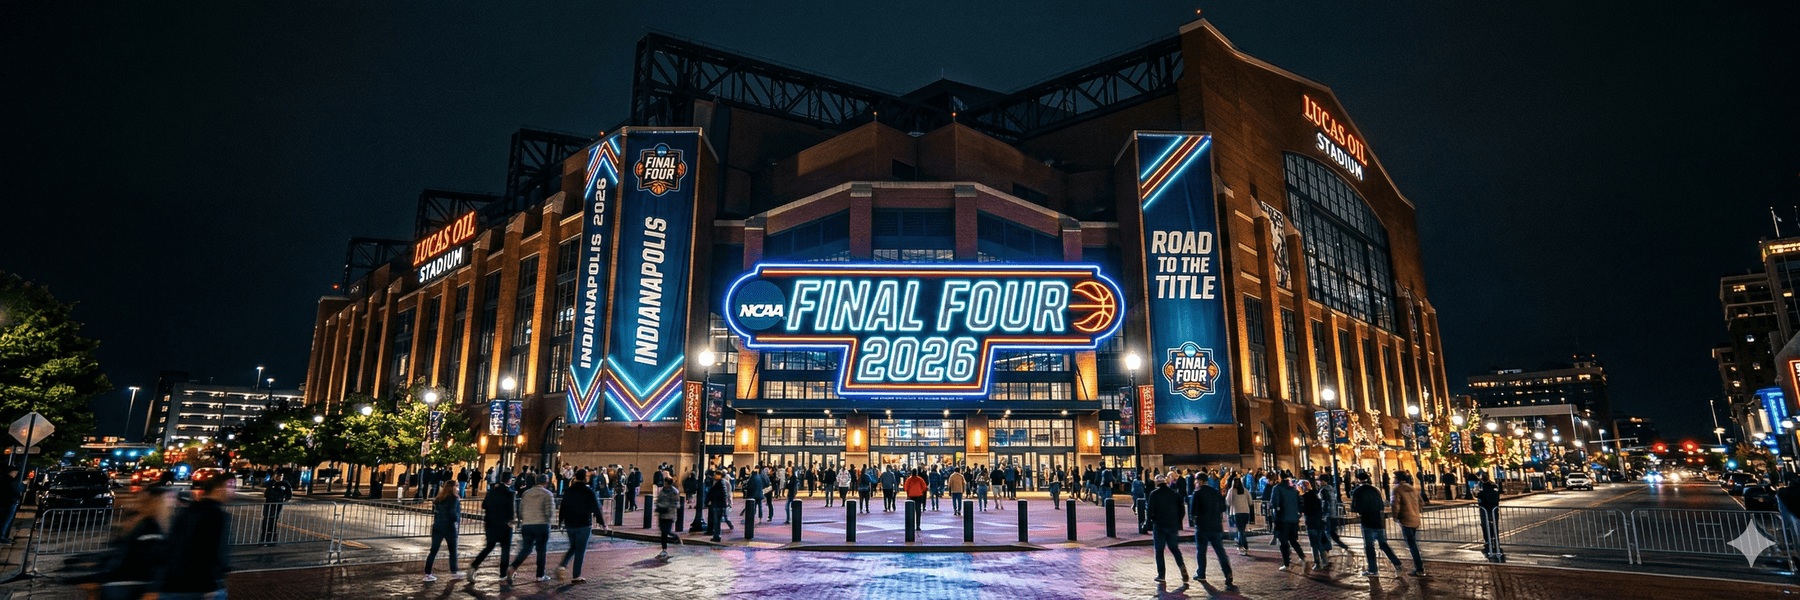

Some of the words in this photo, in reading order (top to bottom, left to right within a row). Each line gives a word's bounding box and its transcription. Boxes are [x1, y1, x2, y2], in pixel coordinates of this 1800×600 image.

[1304, 94, 1345, 146] LUCAS
[1347, 133, 1368, 166] OIL
[645, 156, 676, 169] FINAL
[1316, 132, 1363, 181] STADIUM
[644, 168, 675, 180] FOUR
[413, 225, 451, 266] LUCAS
[452, 211, 475, 244] OIL
[1151, 230, 1213, 255] ROAD
[419, 246, 463, 283] STADIUM
[580, 233, 602, 369] INDIANAPOLIS
[593, 177, 607, 226] 2026
[1157, 256, 1178, 273] TO
[1180, 256, 1210, 273] THE
[634, 216, 667, 366] INDIANAPOLIS
[1155, 275, 1216, 300] TITLE
[739, 304, 784, 318] NCAA
[786, 280, 923, 332] FINAL
[937, 280, 1069, 332] FOUR
[857, 336, 977, 382] 2026
[1175, 356, 1208, 370] FINAL
[1176, 369, 1207, 382] FOUR
